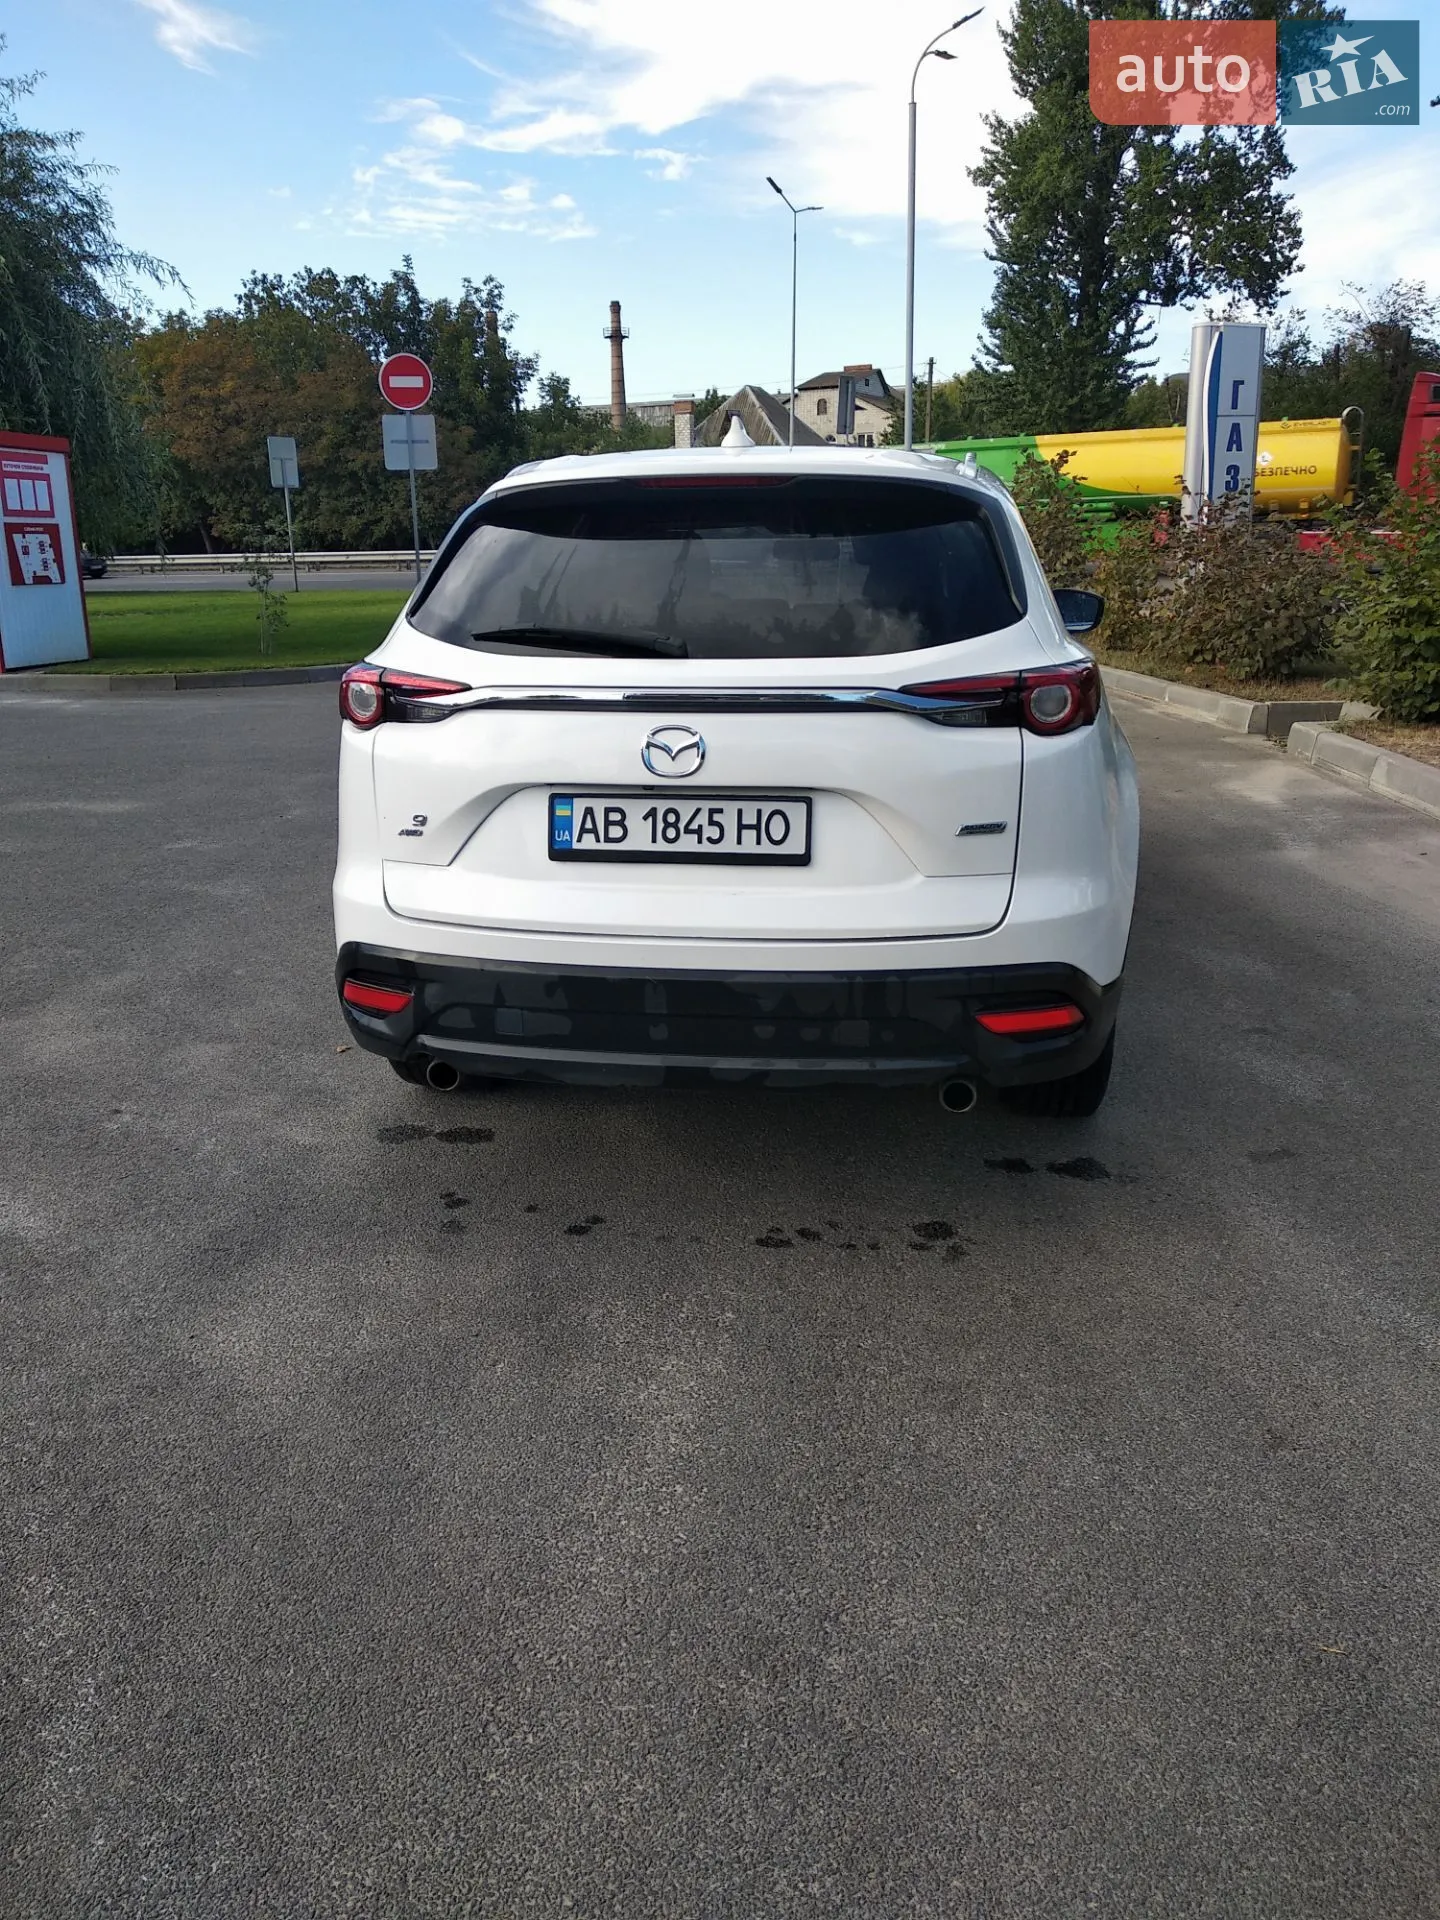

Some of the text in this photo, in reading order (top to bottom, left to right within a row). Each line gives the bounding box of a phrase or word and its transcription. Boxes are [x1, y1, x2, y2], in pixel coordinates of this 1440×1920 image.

[1224, 380, 1245, 492] ГАЗ
[412, 814, 428, 827] 9
[576, 806, 790, 846] AB 1845 HO
[555, 830, 571, 842] UA
